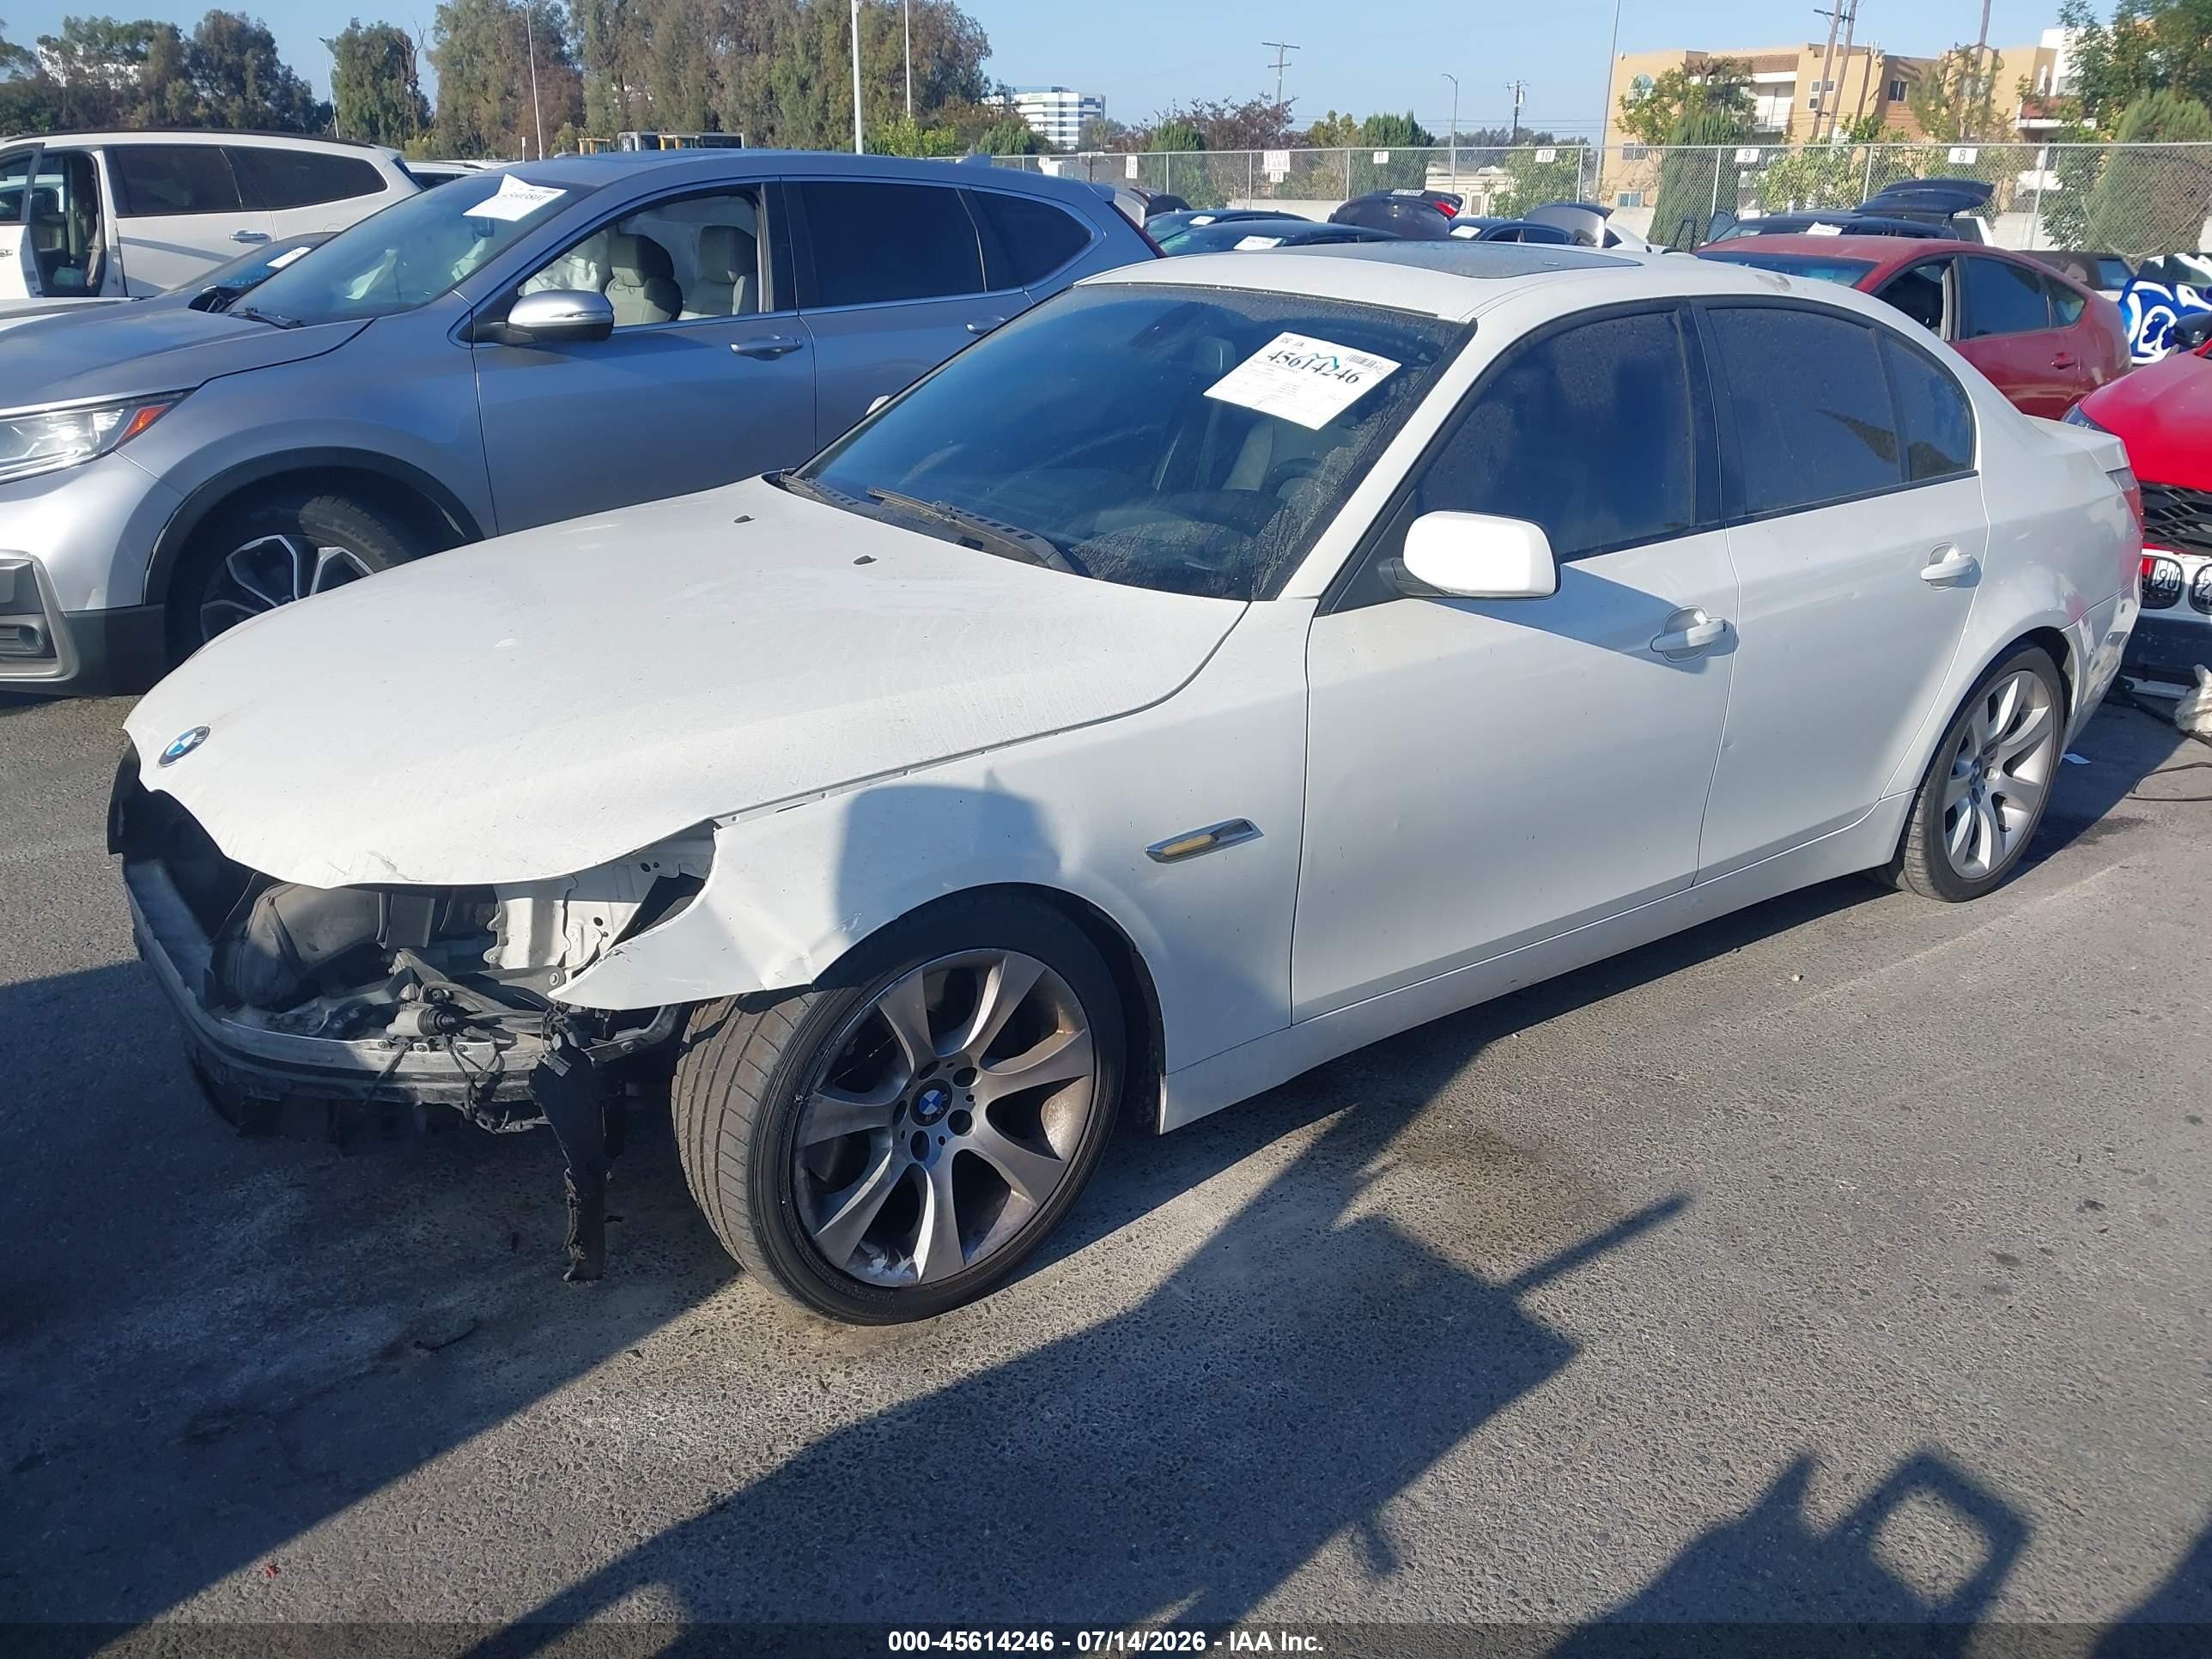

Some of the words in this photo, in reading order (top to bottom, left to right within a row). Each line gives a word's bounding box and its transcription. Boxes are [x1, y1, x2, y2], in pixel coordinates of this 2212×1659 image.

[1541, 150, 1552, 161] 10
[1744, 150, 1751, 161] 9
[1959, 149, 1966, 161] 8
[1273, 172, 1281, 181] 12
[1267, 350, 1367, 384] 45614246
